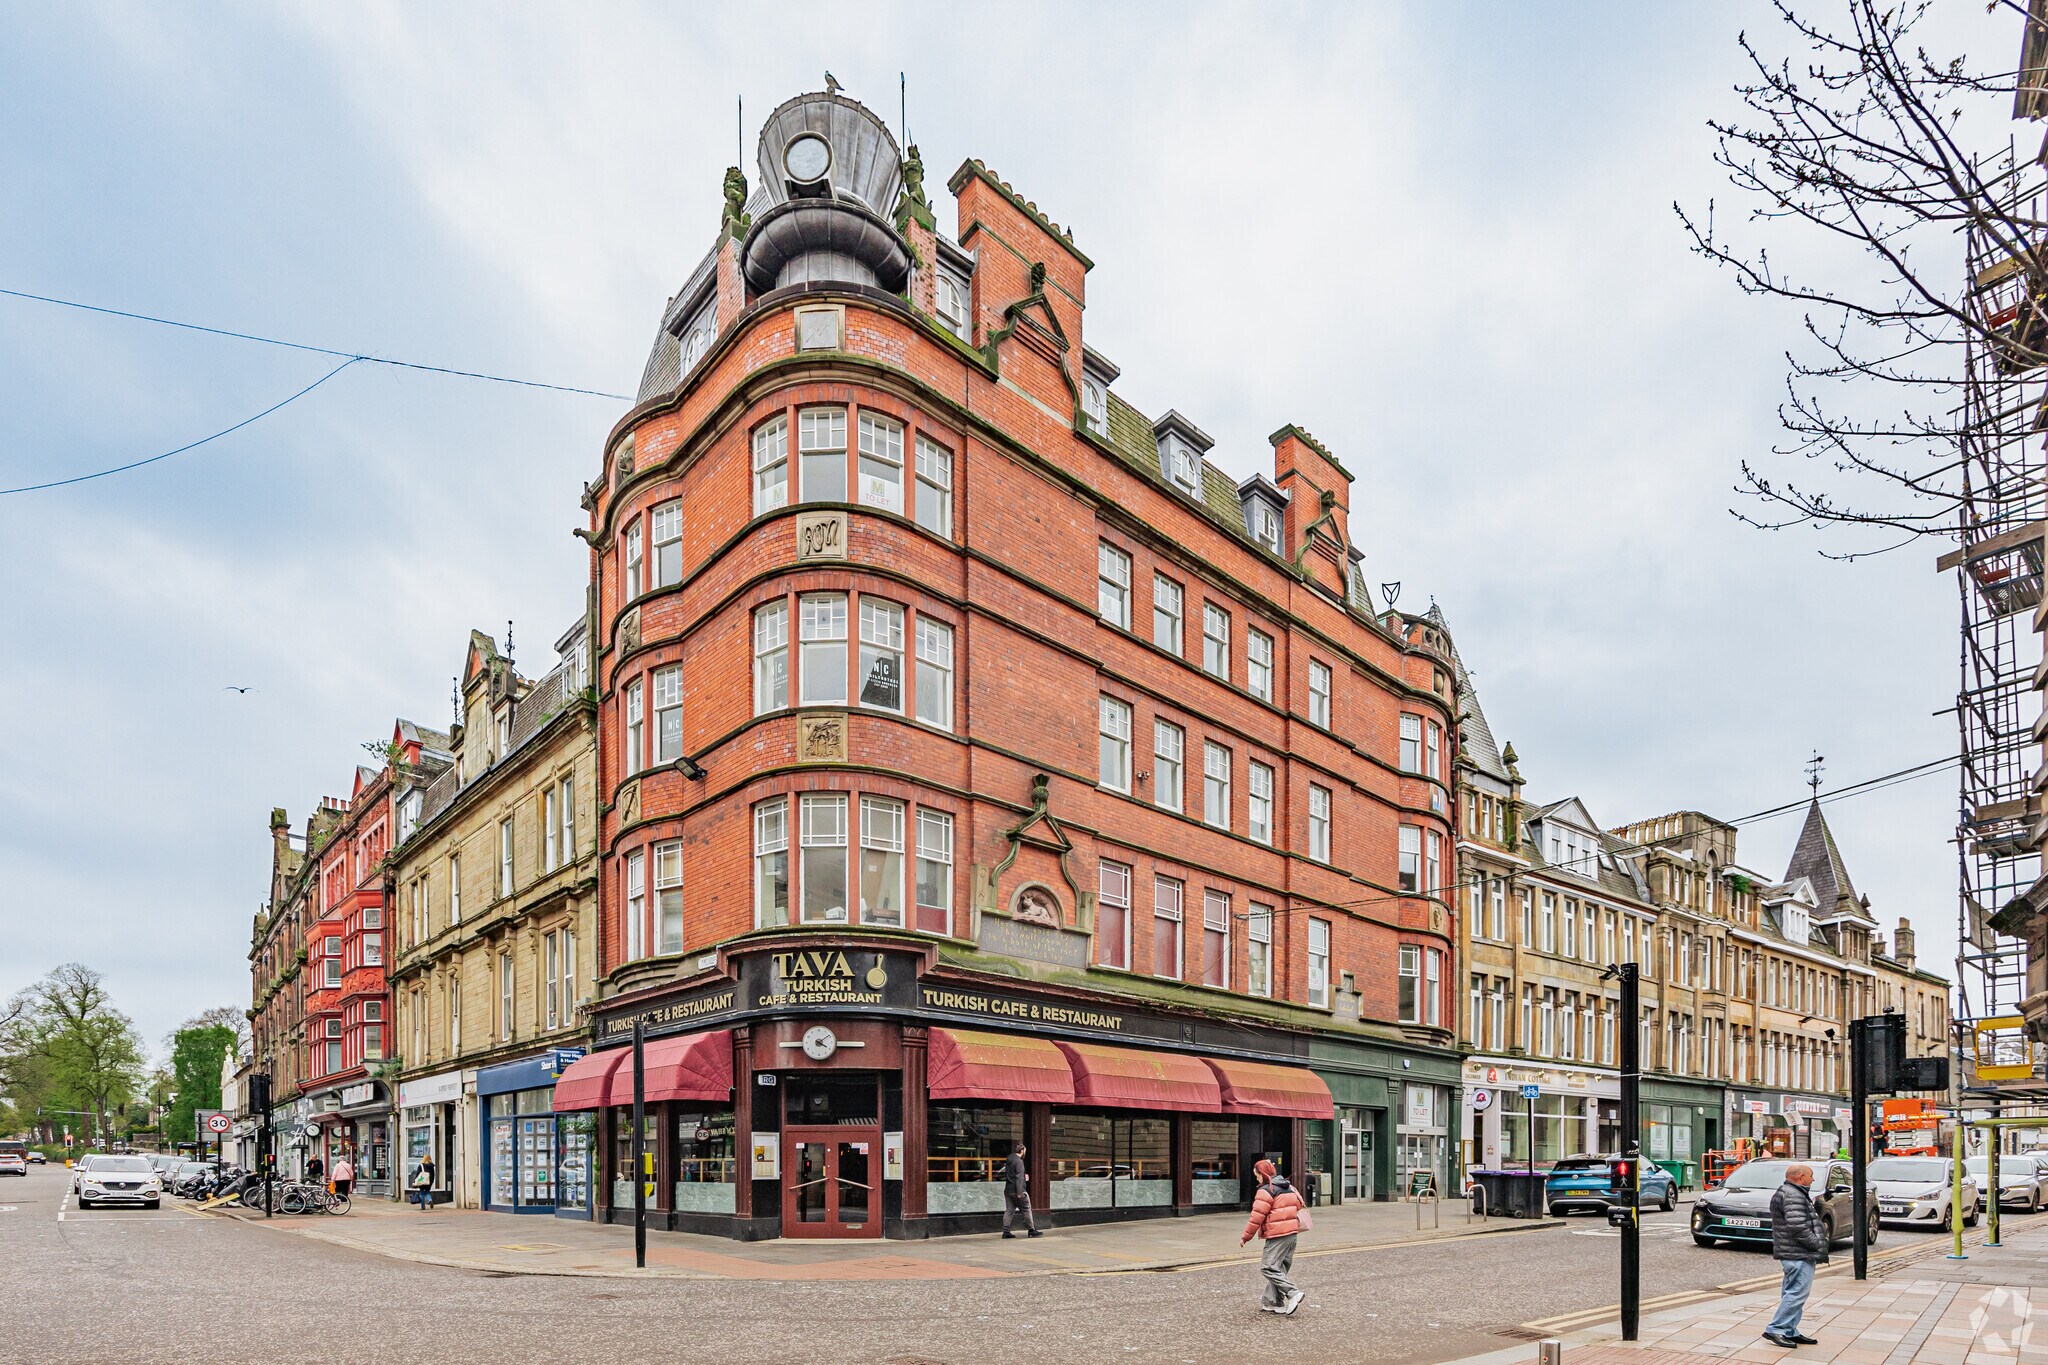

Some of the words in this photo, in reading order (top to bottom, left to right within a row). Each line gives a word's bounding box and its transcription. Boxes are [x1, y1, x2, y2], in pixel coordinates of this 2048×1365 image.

[865, 493, 875, 502] TO
[876, 497, 890, 506] LET
[772, 951, 855, 979] TAVA
[784, 979, 852, 993] TURKISH
[759, 994, 787, 1006] CAFE
[789, 994, 797, 1004] &
[799, 992, 882, 1004] RESTAURANT
[664, 1008, 671, 1021] &
[671, 993, 734, 1019] RESTAURANT
[923, 989, 988, 1012] TURKISH
[990, 1000, 1028, 1017] CAFE
[1030, 1005, 1040, 1018] &
[1042, 1007, 1122, 1030] RESTAURANT
[1420, 1108, 1428, 1116] LET
[1795, 1100, 1821, 1113] COUNTRY
[211, 1119, 227, 1127] 30
[1726, 1218, 1744, 1226] SA22
[1745, 1219, 1760, 1227] VGD
